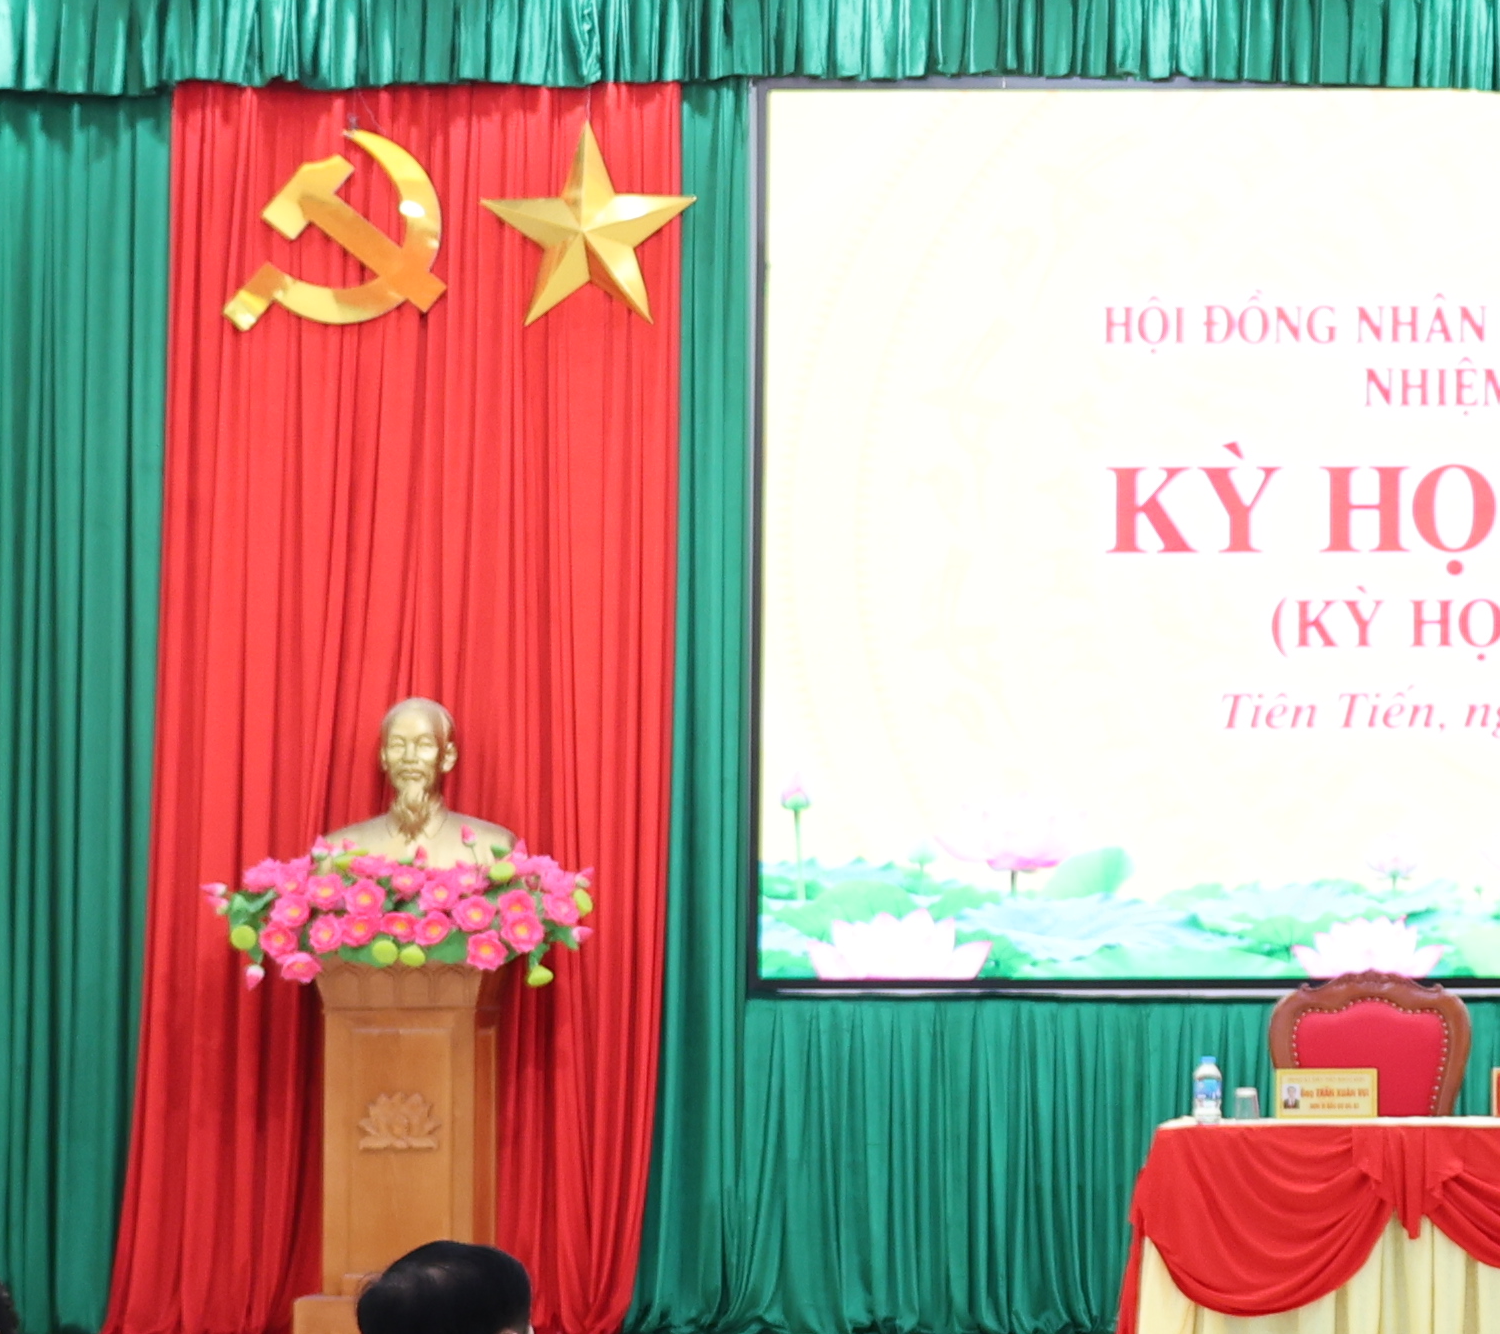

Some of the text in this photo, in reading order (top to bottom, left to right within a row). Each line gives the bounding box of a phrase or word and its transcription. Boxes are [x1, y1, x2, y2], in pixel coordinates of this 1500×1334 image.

[1106, 297, 1183, 353] HỘI
[1204, 291, 1336, 344] ĐỒNG
[1358, 293, 1485, 343] NHÂN
[1107, 441, 1281, 554] KỲ
[1271, 586, 1383, 656] (KỲ
[1222, 693, 1317, 729] Tiên
[1340, 686, 1447, 731] Tiến,
